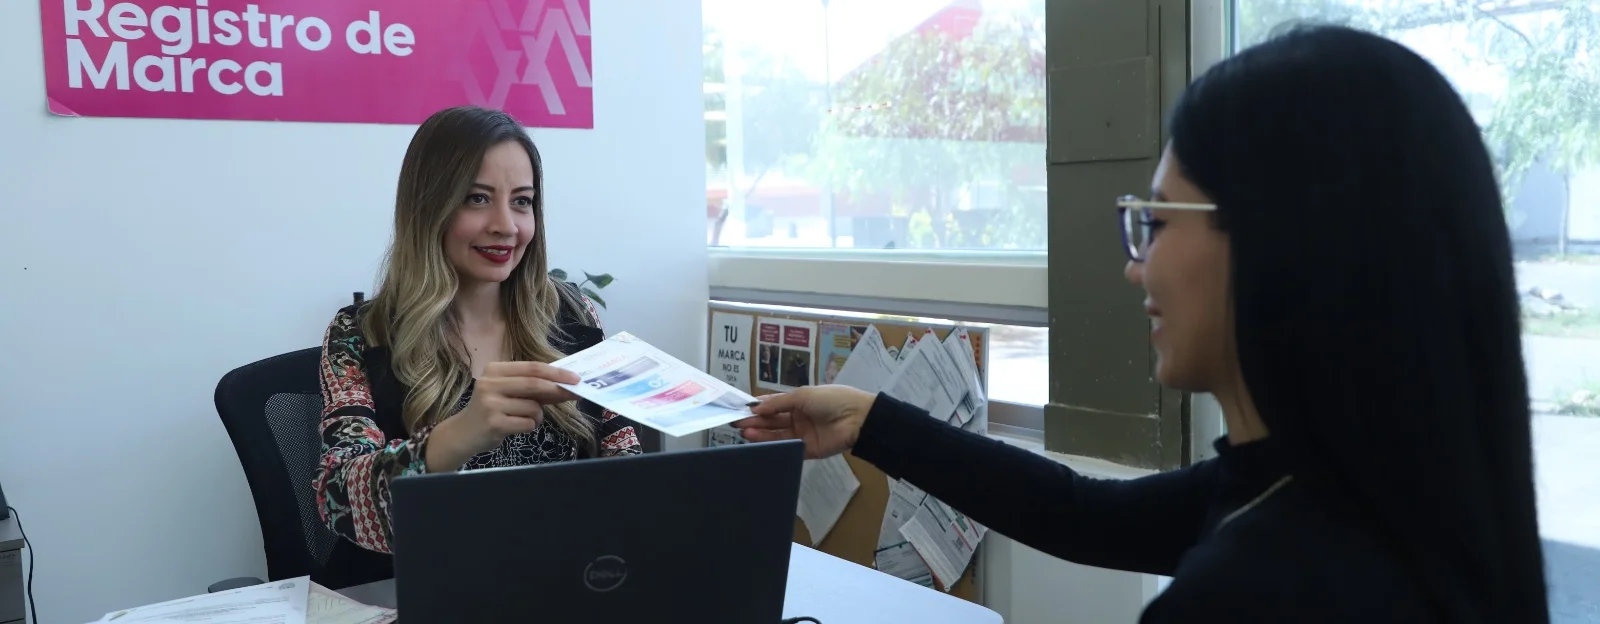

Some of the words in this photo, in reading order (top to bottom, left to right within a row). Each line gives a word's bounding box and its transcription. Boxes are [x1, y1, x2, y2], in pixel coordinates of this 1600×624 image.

[63, 0, 332, 56] Registro
[345, 11, 415, 56] de
[66, 38, 284, 96] Marca
[724, 325, 738, 343] TU
[718, 348, 745, 361] MARCA
[722, 363, 732, 372] NO
